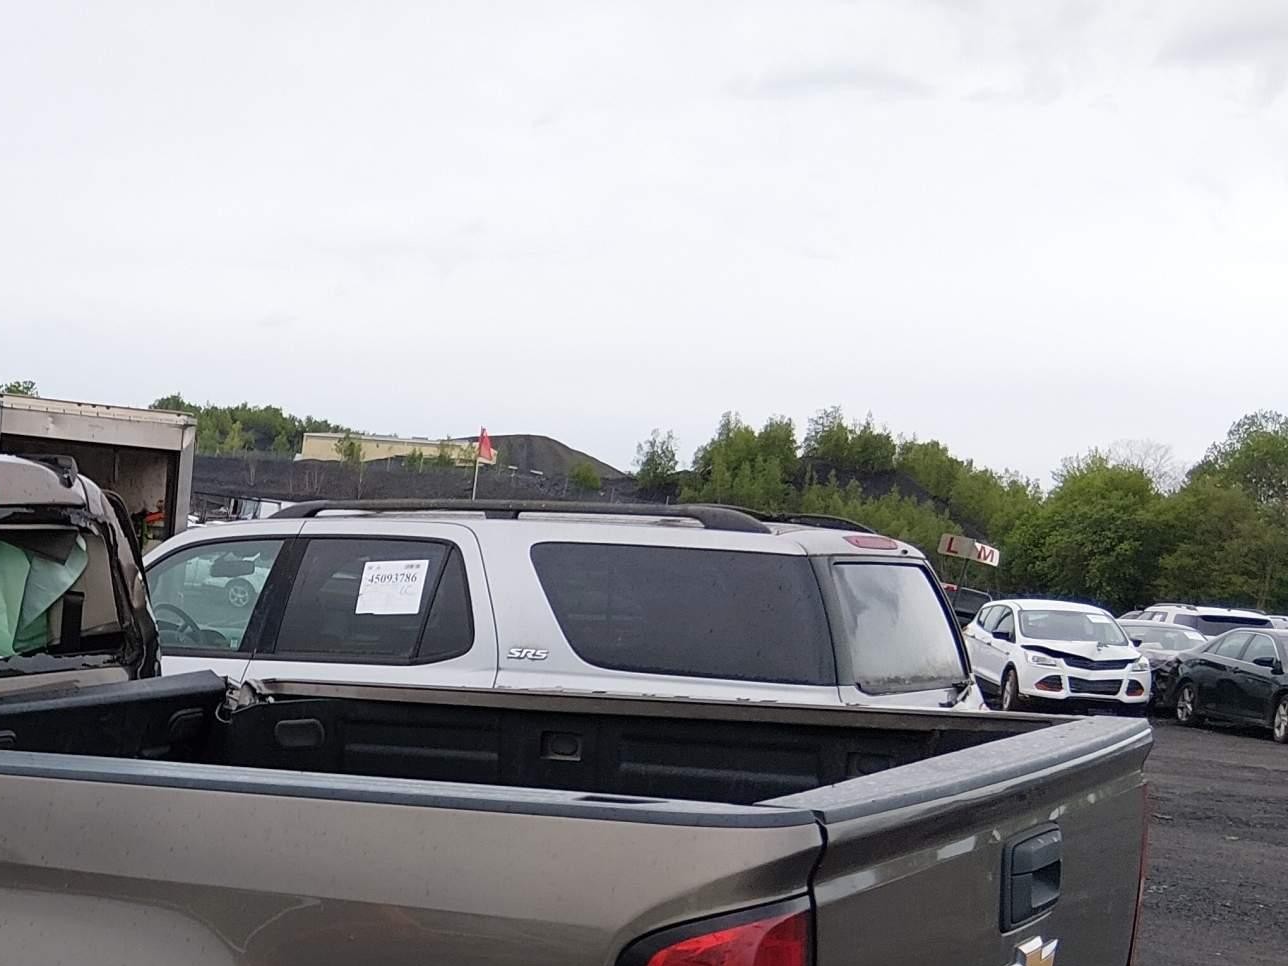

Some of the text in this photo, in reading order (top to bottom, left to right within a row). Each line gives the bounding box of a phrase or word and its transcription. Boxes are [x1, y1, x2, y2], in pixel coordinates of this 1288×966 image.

[946, 537, 958, 554] L
[368, 572, 417, 585] 45093786
[507, 648, 549, 661] SRS
